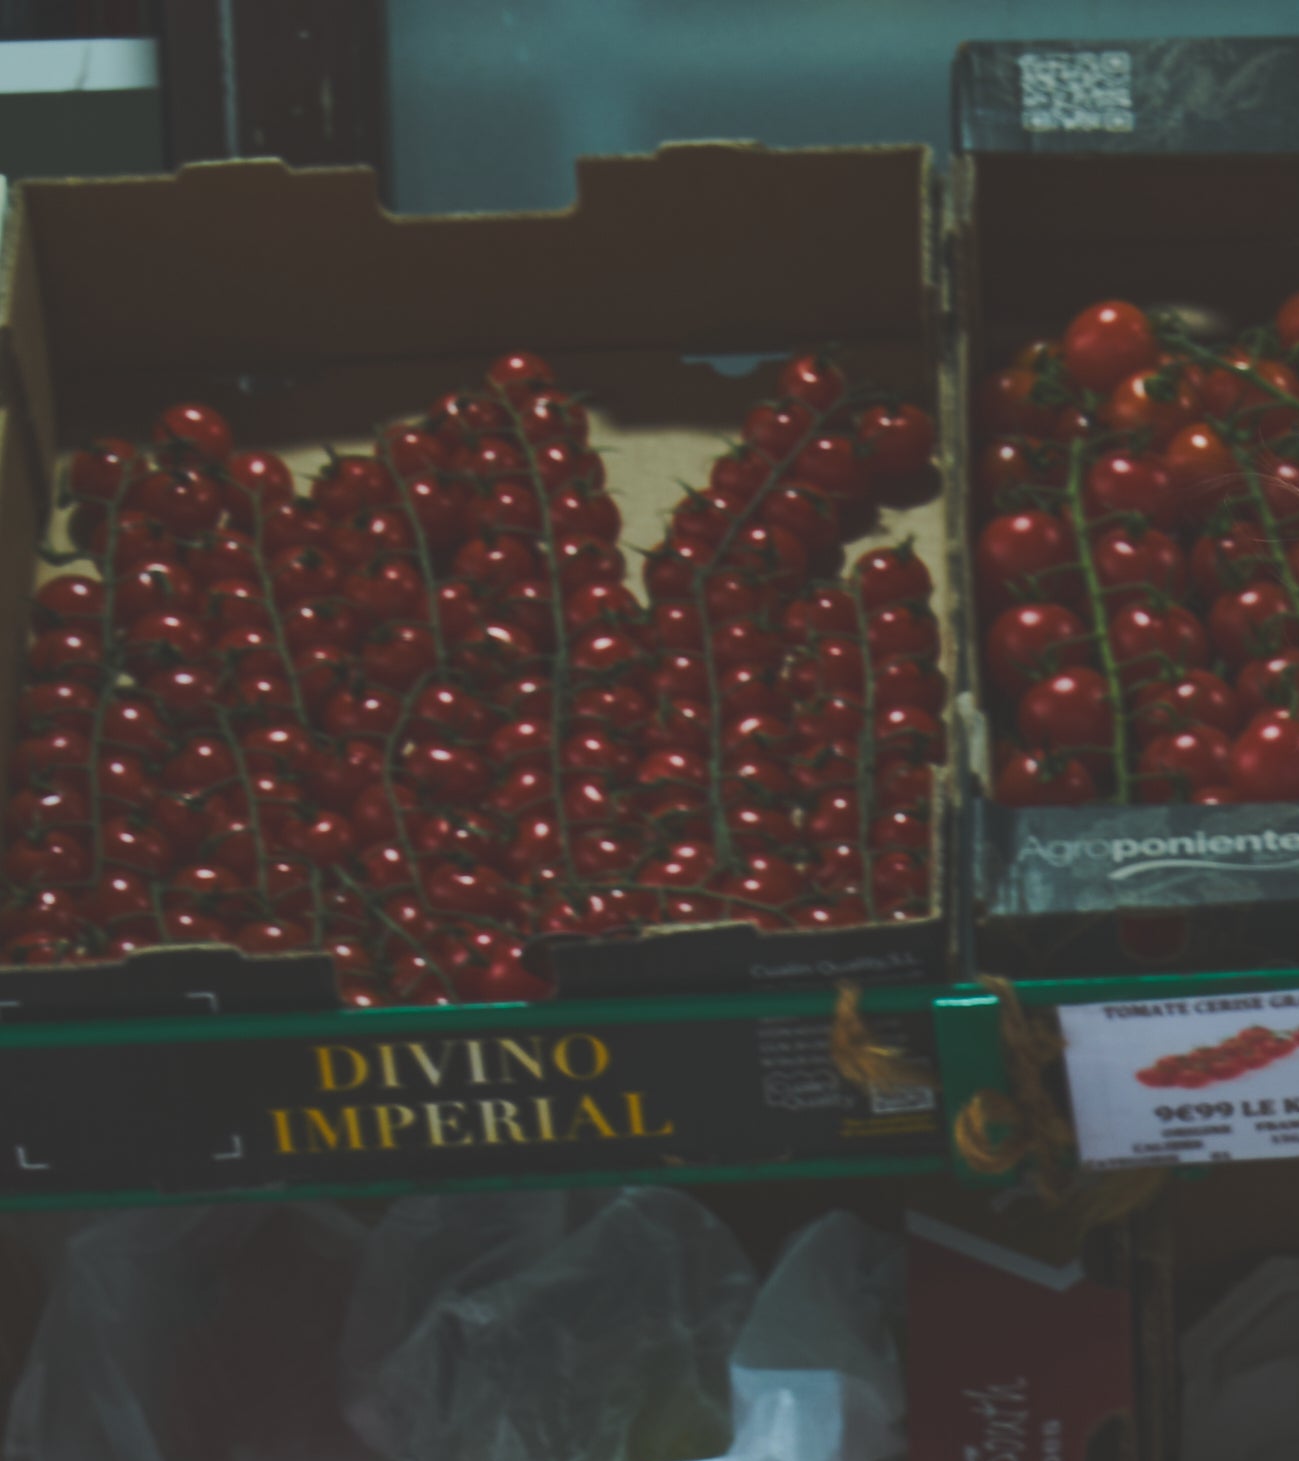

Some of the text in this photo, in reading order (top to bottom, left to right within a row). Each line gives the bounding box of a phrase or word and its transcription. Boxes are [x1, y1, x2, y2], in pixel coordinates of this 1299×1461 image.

[1102, 999, 1188, 1021] TOMATE
[314, 1032, 612, 1093] DIVINO
[268, 1090, 675, 1156] IMPERIAL
[1241, 1097, 1277, 1118] LE
